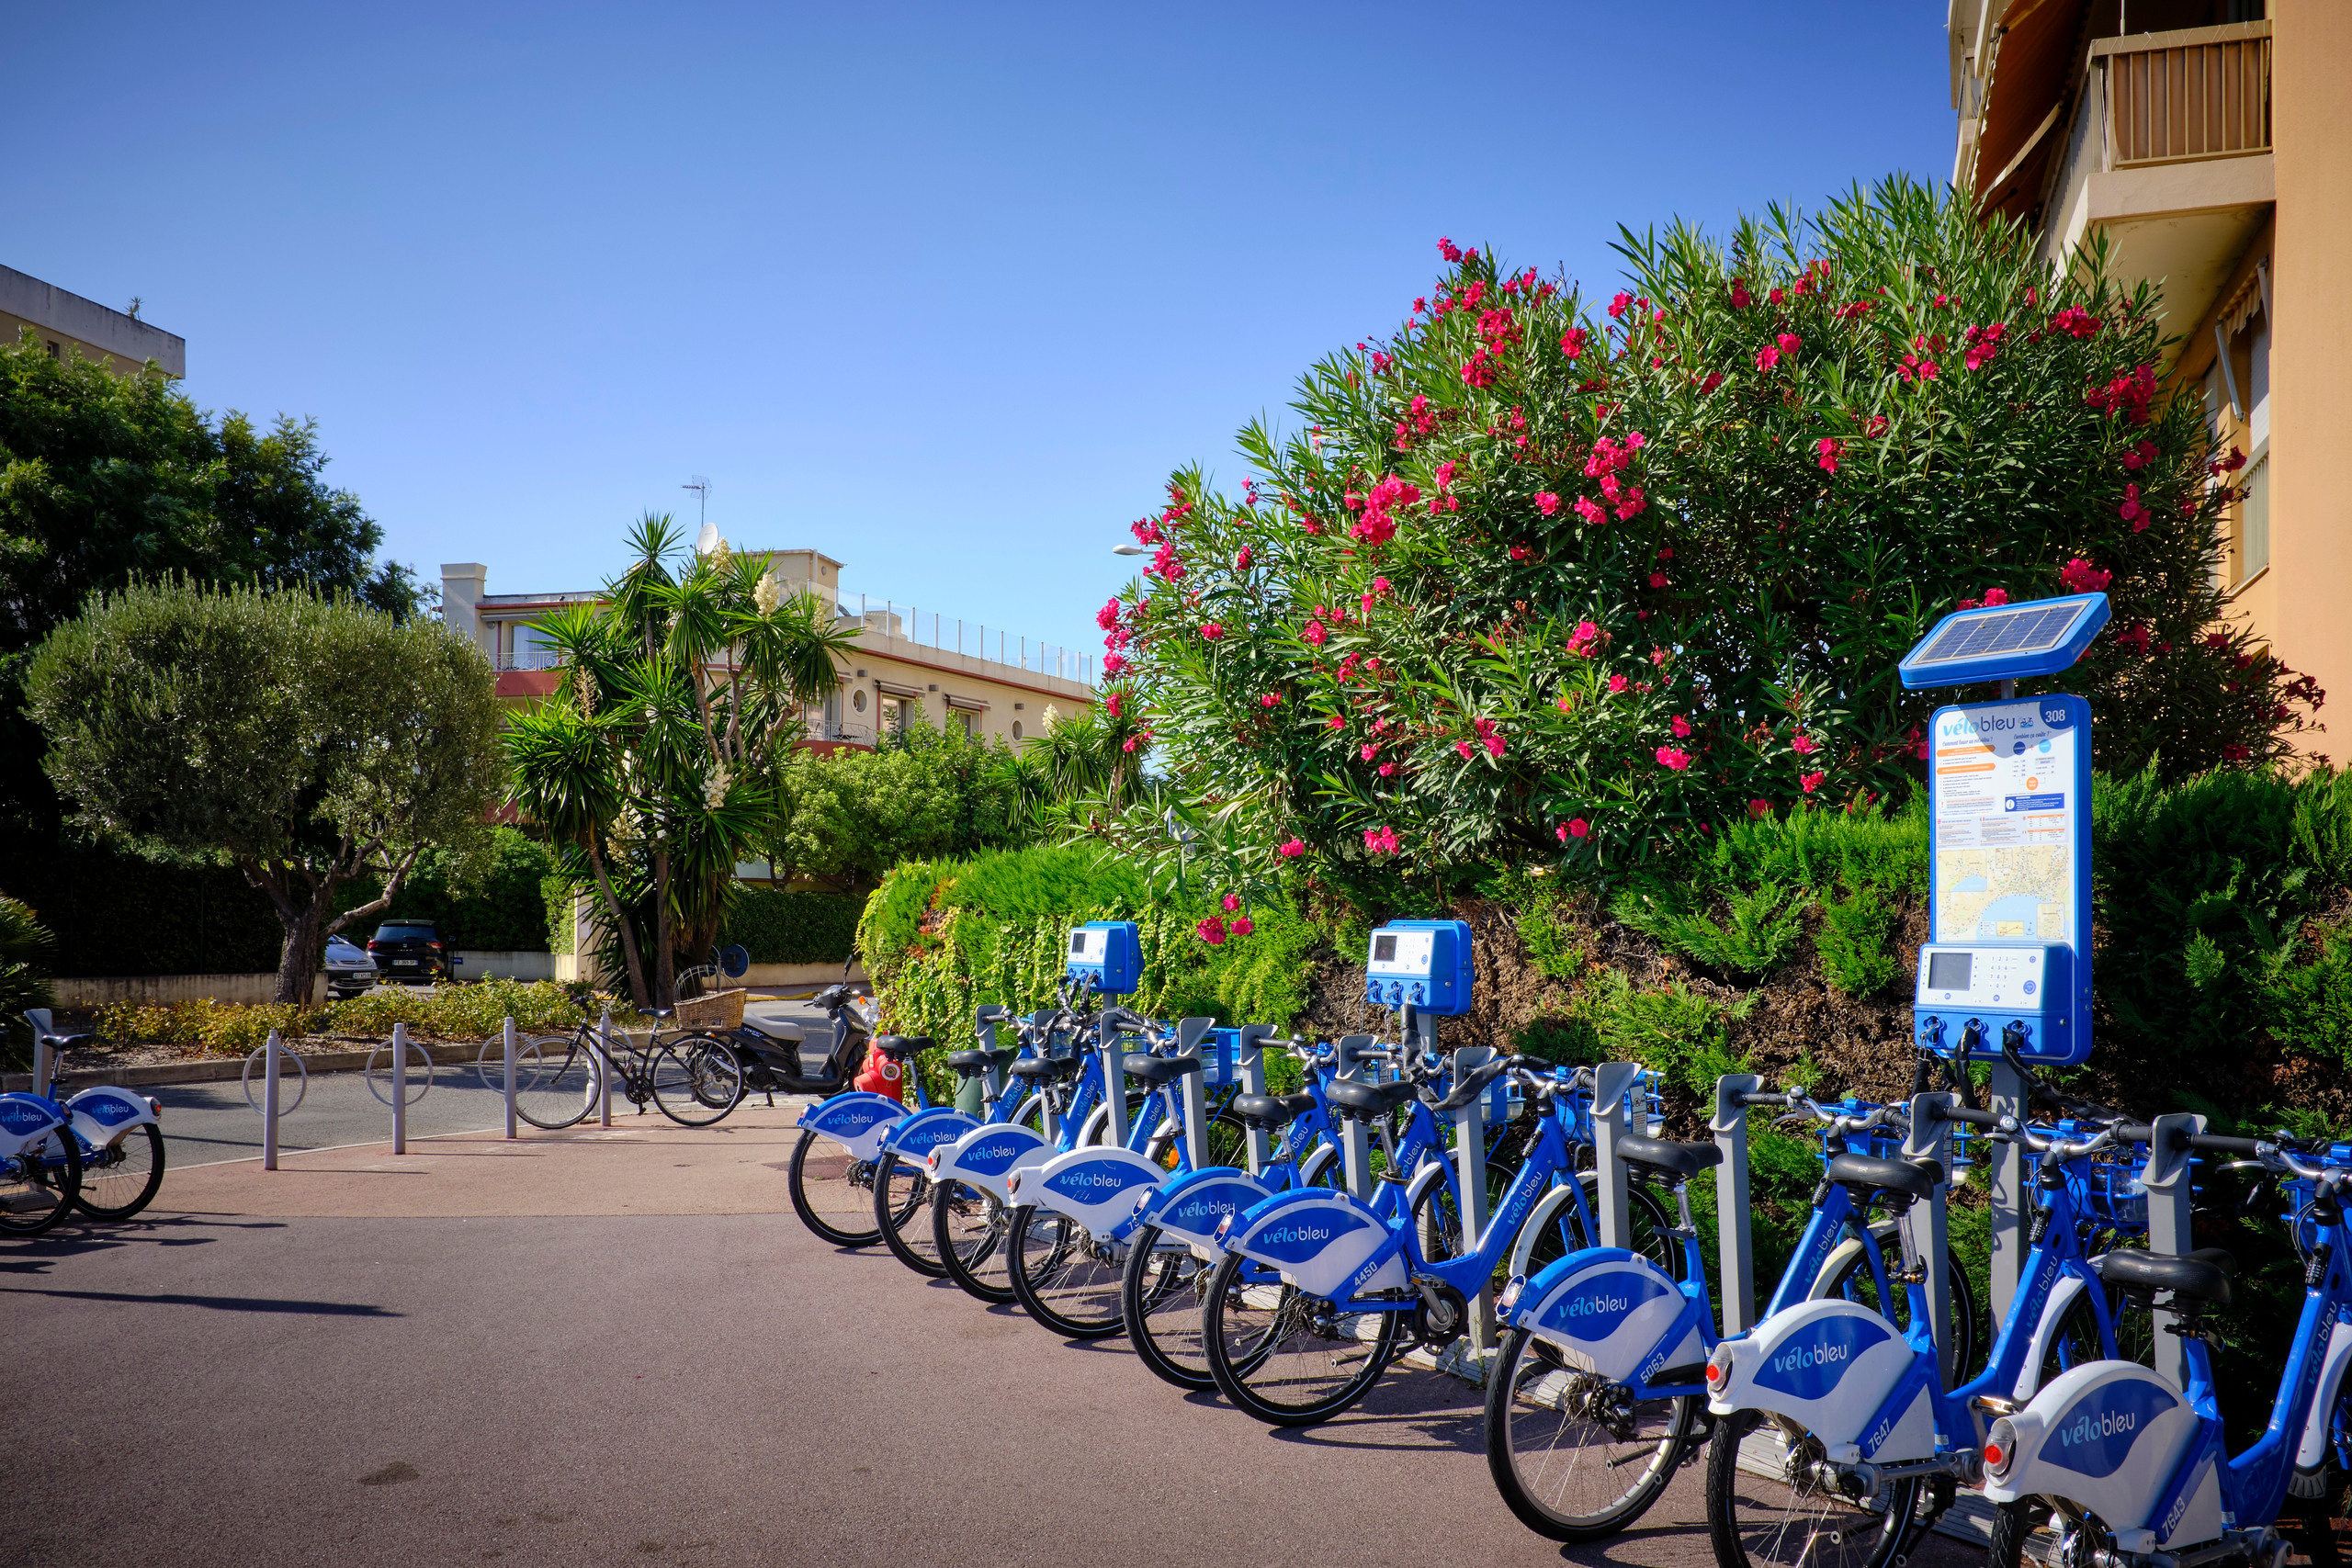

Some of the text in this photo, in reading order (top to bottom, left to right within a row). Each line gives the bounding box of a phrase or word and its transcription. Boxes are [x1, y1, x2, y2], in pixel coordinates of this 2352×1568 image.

[1942, 715, 2016, 737] vélobleu
[2044, 709, 2066, 723] 308
[1004, 1078, 1025, 1110] véloble
[827, 1113, 874, 1125] vélobleu
[910, 1132, 956, 1145] vélobleu
[967, 1145, 1015, 1161] vélobleu
[1060, 1171, 1122, 1188] vélobleu
[1178, 1201, 1236, 1218] vélobleu
[1507, 1171, 1543, 1225] vélobleu
[1263, 1225, 1329, 1245] vélobleu
[1804, 1219, 1838, 1283] vélobleu
[1353, 1260, 1378, 1287] 4450
[2026, 1255, 2058, 1328] vélobleu
[1559, 1294, 1628, 1319] vélobleu
[1774, 1342, 1848, 1373] vélobleu
[2307, 1301, 2337, 1385] vélobleu
[1639, 1352, 1666, 1384] 5063
[1867, 1417, 1891, 1453] 7647
[2061, 1410, 2135, 1448] vélobleu
[2161, 1496, 2187, 1539] 7643
